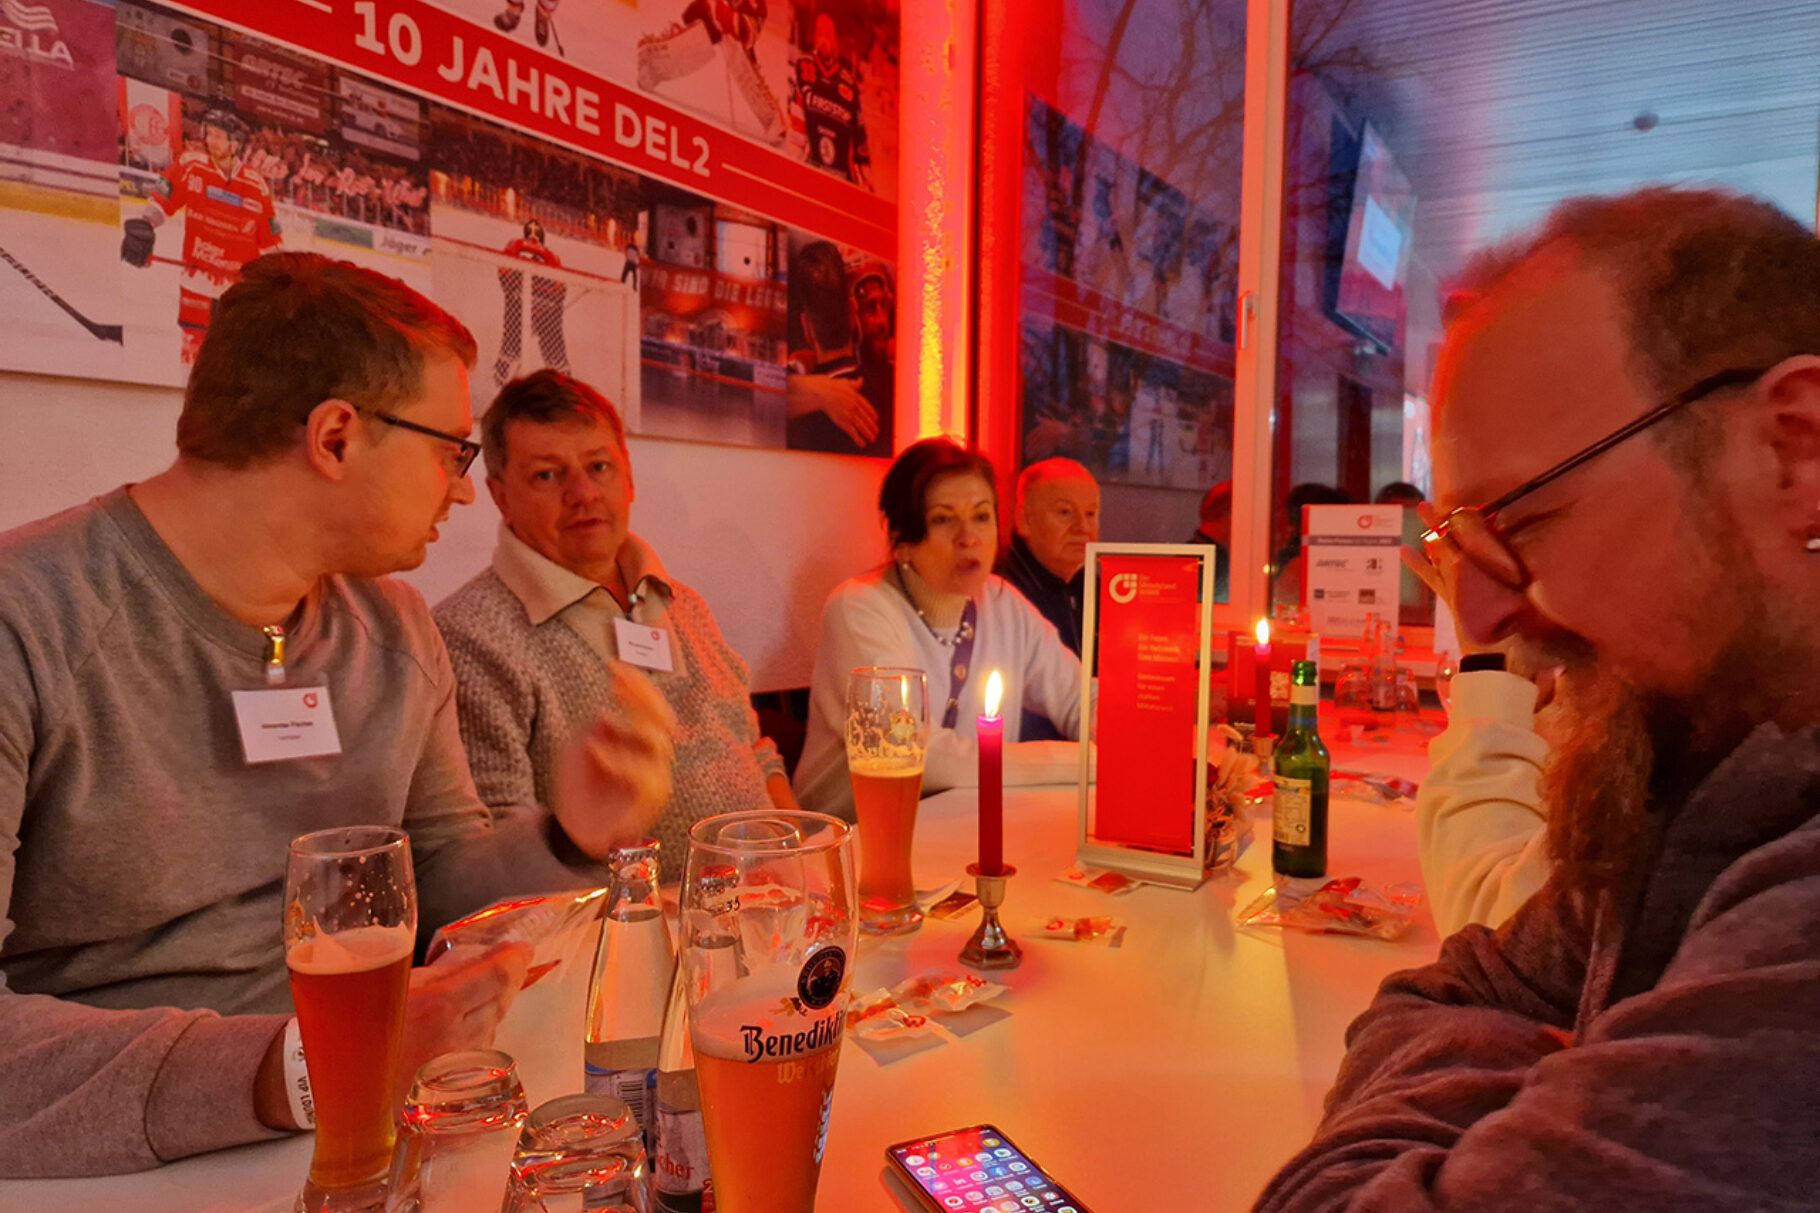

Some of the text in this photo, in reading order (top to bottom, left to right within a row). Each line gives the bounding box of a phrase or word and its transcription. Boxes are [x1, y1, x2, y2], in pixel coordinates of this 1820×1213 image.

[355, 1, 422, 67] 10
[437, 36, 600, 136] JAHRE
[615, 102, 711, 178] DEL2
